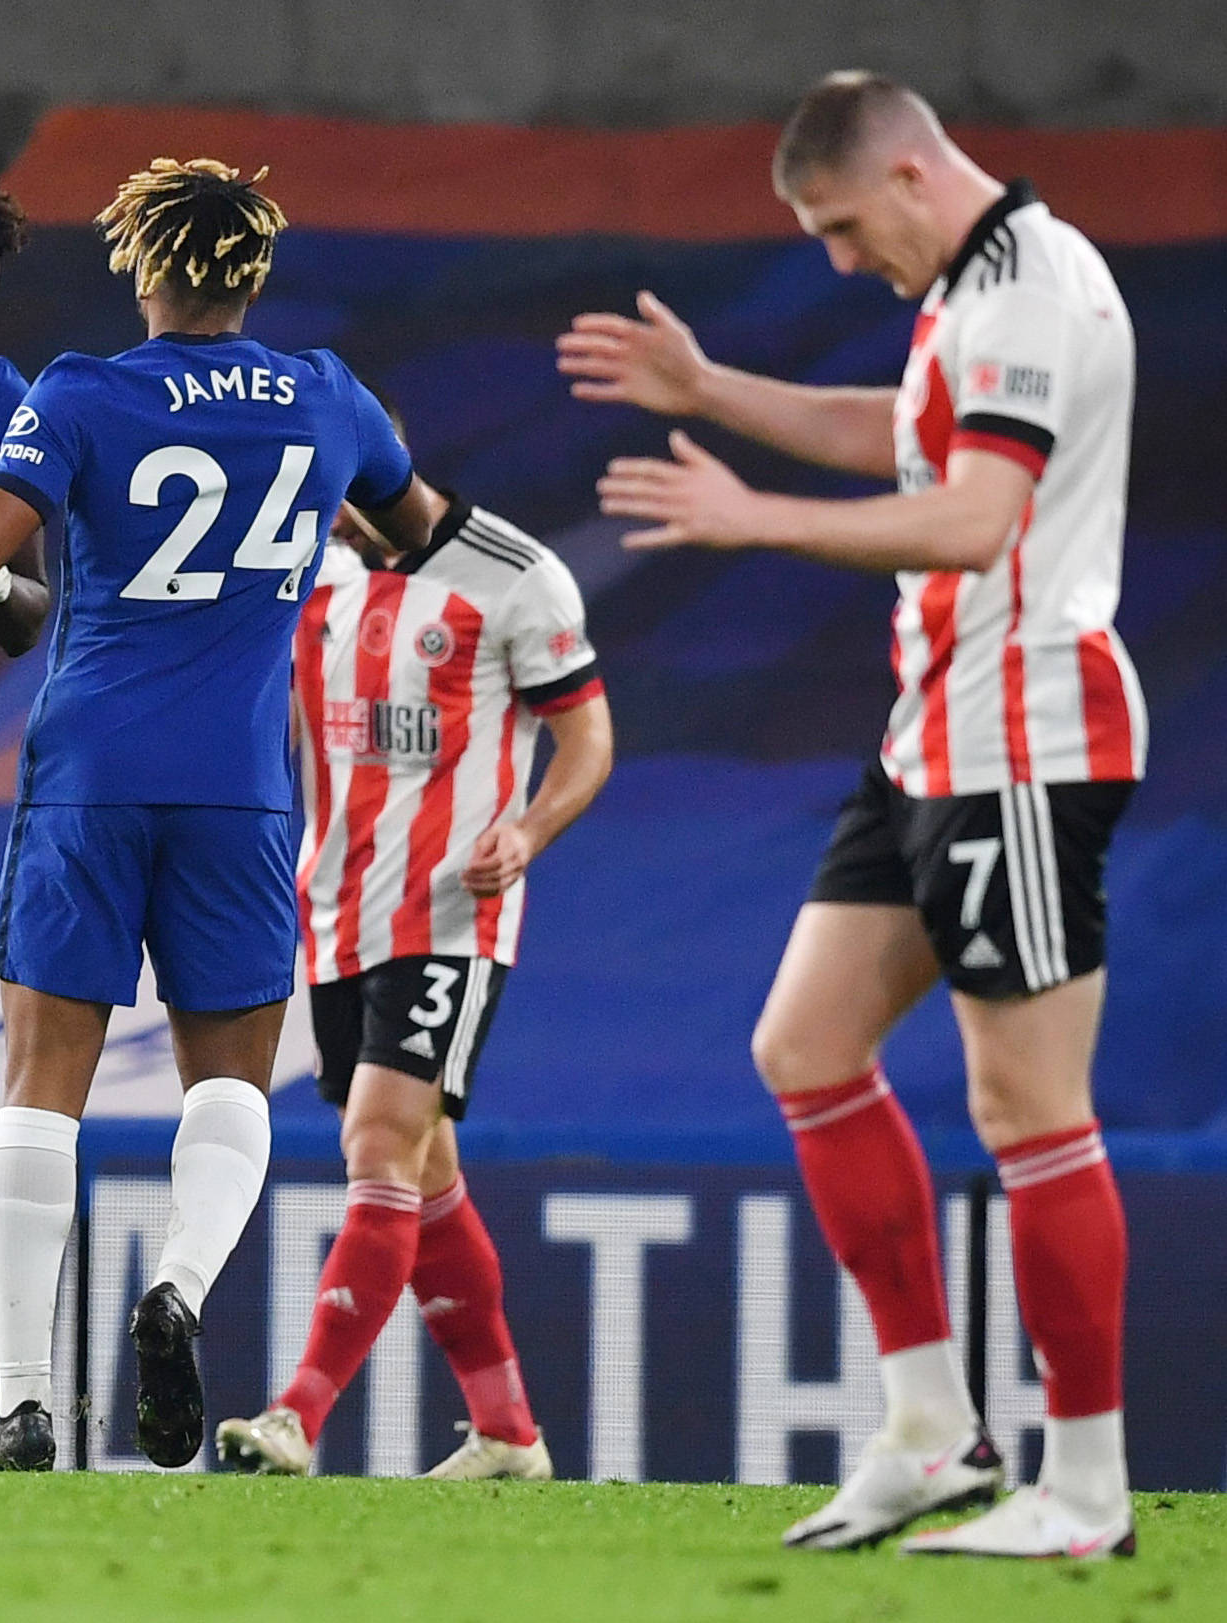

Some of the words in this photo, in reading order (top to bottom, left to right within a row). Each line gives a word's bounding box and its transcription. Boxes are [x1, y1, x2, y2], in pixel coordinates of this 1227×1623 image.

[164, 366, 295, 412] JAMES
[0, 443, 44, 465] NDAI
[119, 445, 319, 601] 24
[374, 702, 439, 754] USG
[948, 837, 1002, 930] 7
[408, 962, 461, 1028] 3
